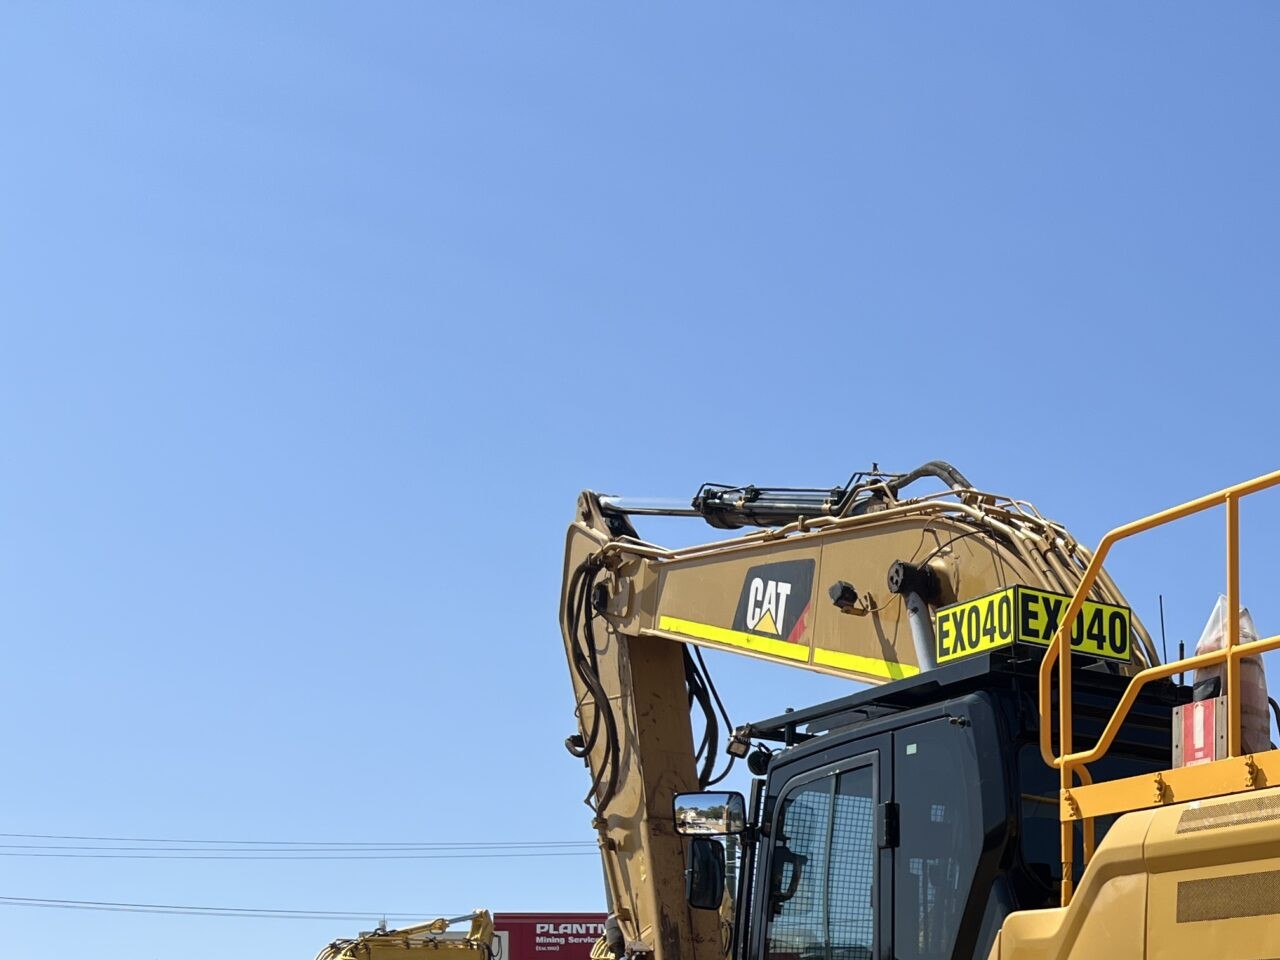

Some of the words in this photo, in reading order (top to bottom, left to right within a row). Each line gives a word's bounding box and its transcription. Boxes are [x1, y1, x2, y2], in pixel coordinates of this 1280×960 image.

[746, 577, 792, 636] CAT
[938, 595, 1012, 658] EX040
[535, 936, 566, 945] Mining
